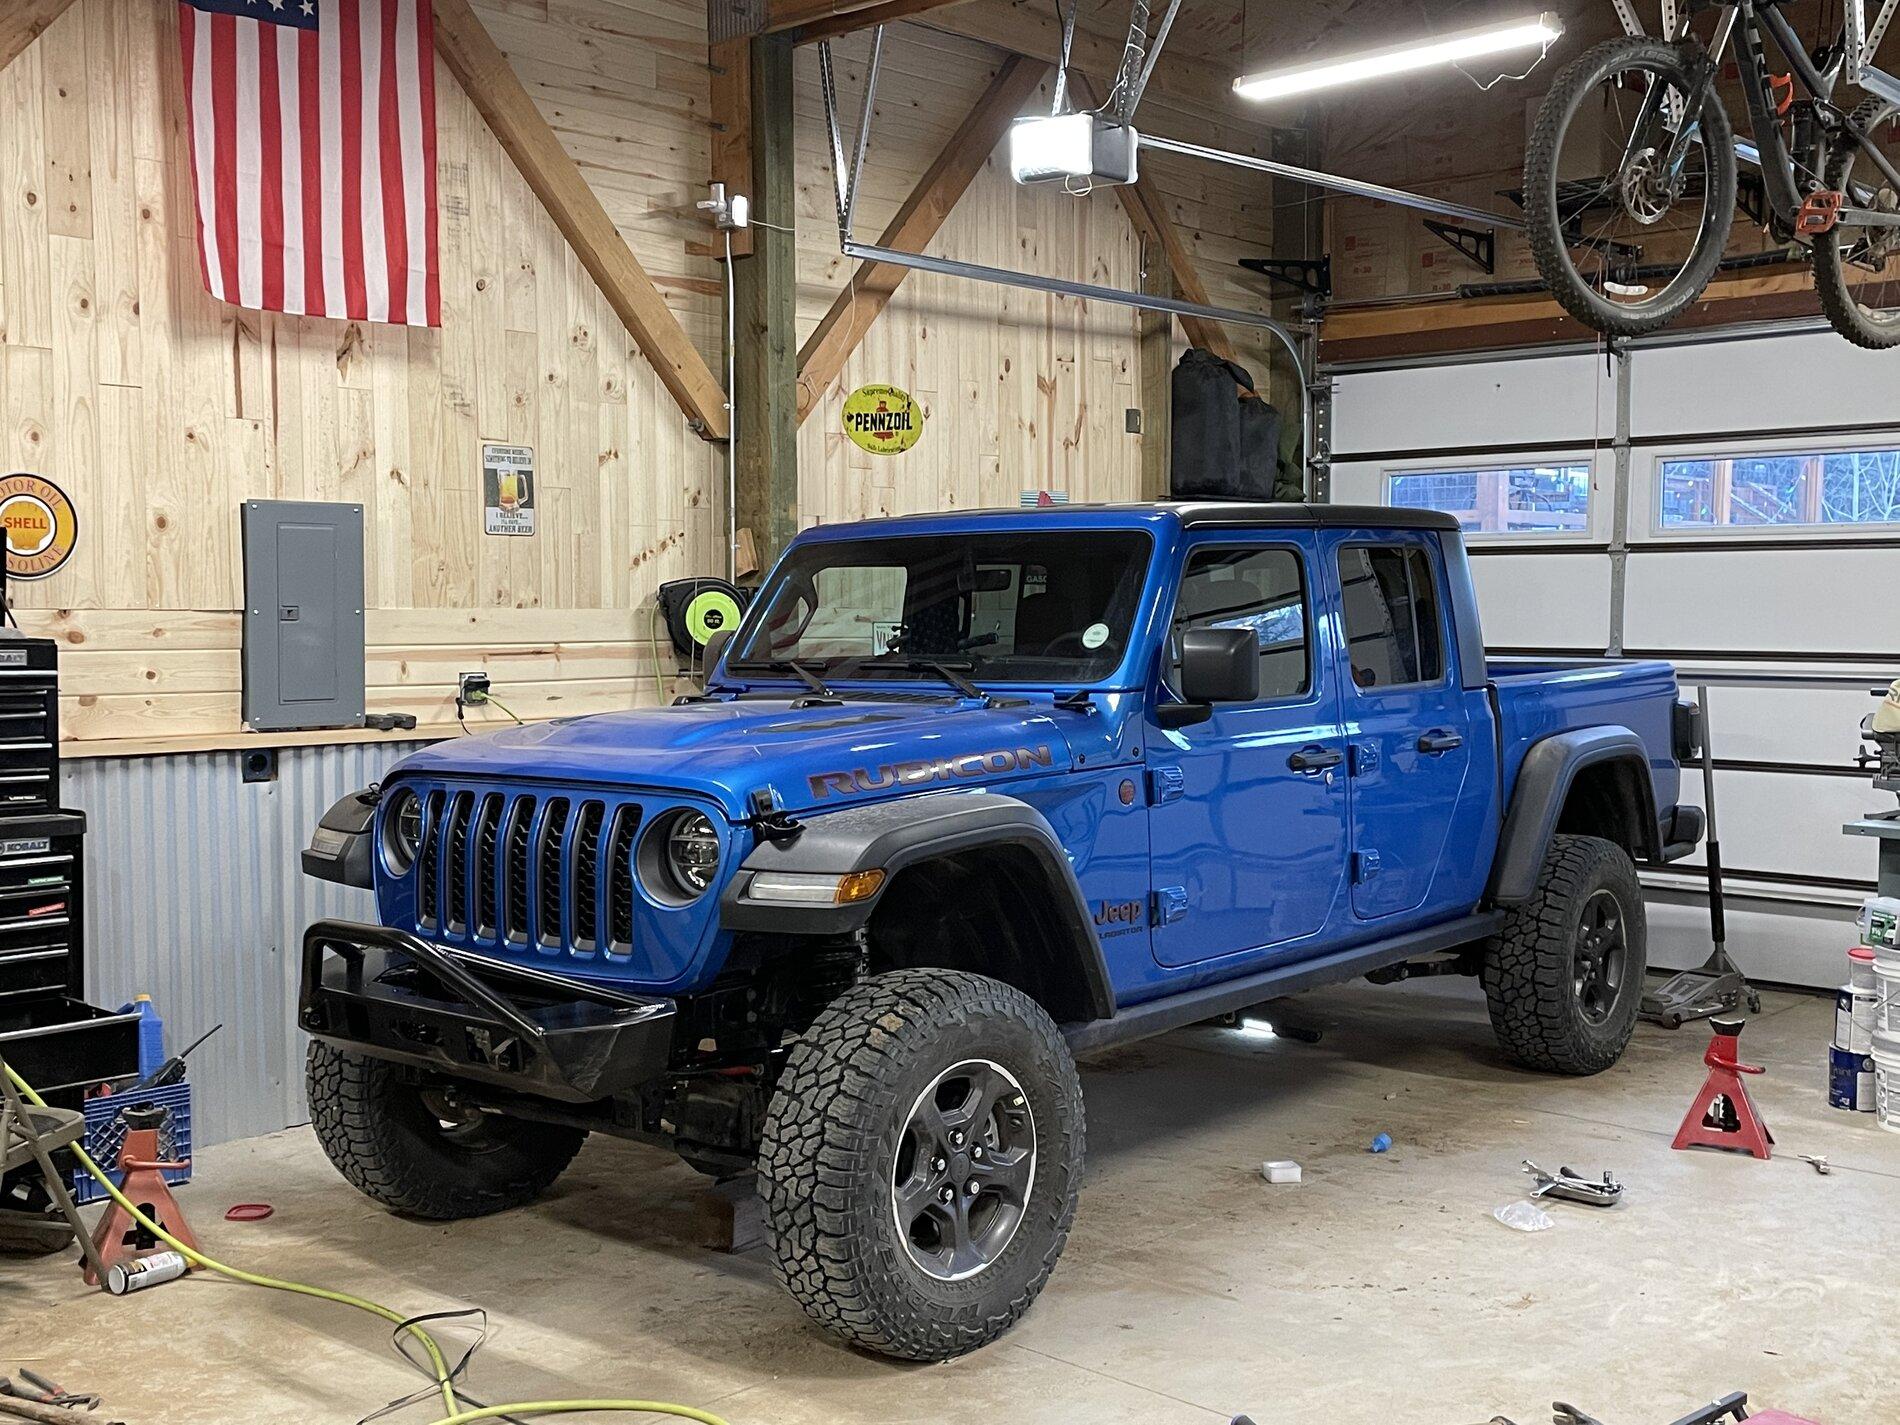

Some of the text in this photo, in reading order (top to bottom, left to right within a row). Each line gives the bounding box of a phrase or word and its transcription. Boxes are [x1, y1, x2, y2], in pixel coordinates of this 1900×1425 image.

[855, 412, 913, 432] PENNZOIL
[40, 486, 63, 510] OIL
[4, 517, 47, 529] SHELL
[808, 745, 1054, 799] RUBICON
[7, 841, 48, 853] KOBALT
[1094, 899, 1142, 926] Jeep
